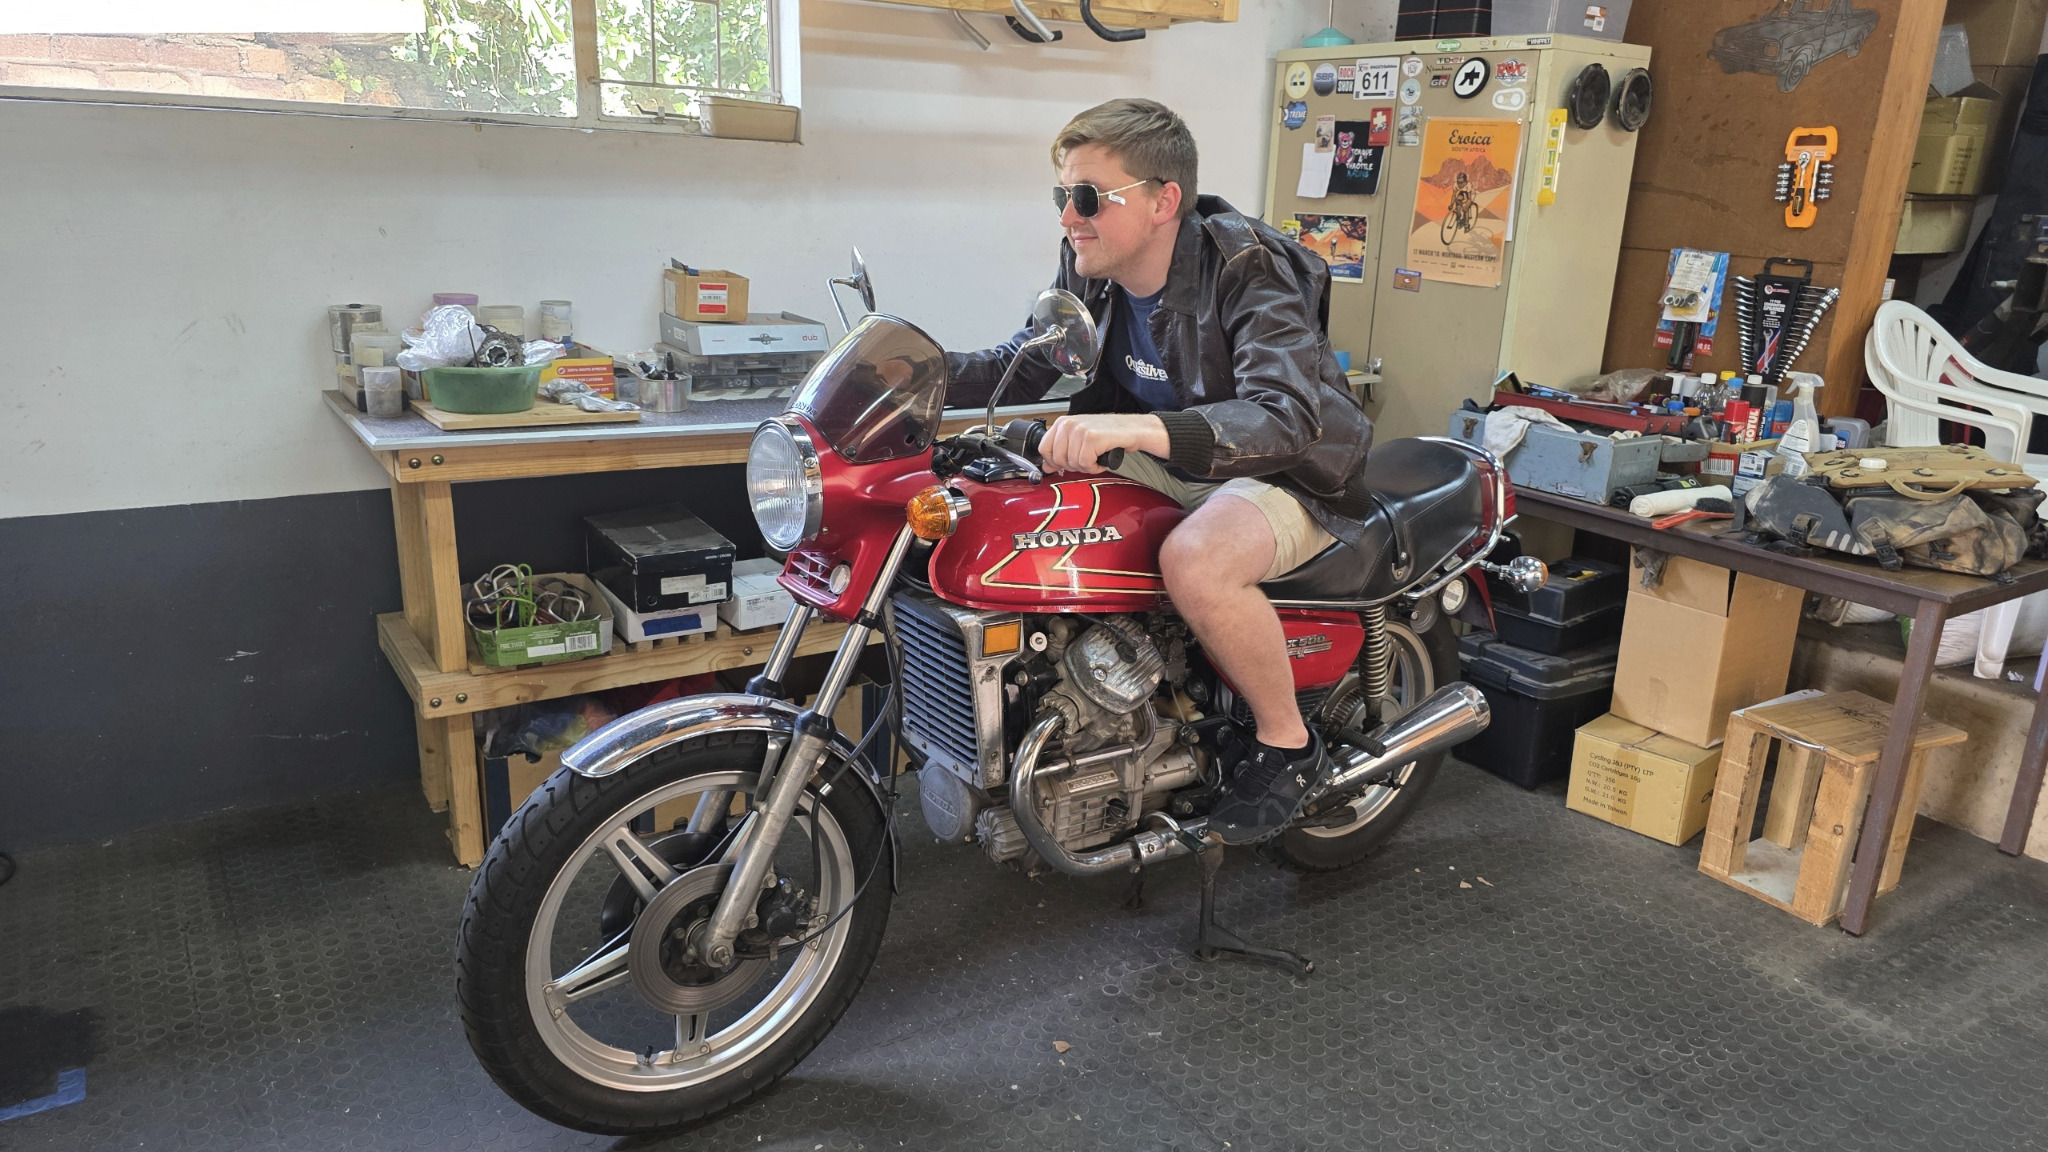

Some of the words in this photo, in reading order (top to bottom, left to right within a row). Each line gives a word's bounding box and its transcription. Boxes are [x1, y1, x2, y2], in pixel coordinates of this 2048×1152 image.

[1362, 71, 1389, 90] 611
[1448, 129, 1492, 145] Eroica
[1345, 162, 1374, 170] THROTTLE
[1013, 525, 1123, 550] HONDA
[1589, 752, 1611, 765] Cycling
[1623, 763, 1641, 773] (PTY)
[1589, 761, 1600, 769] CO2
[1600, 764, 1629, 778] Cartridges
[1630, 774, 1641, 783] 16g
[1602, 791, 1615, 800] 21.0
[1603, 783, 1616, 792] 20.5
[1582, 796, 1599, 807] Made
[1607, 804, 1628, 816] Taiwan
